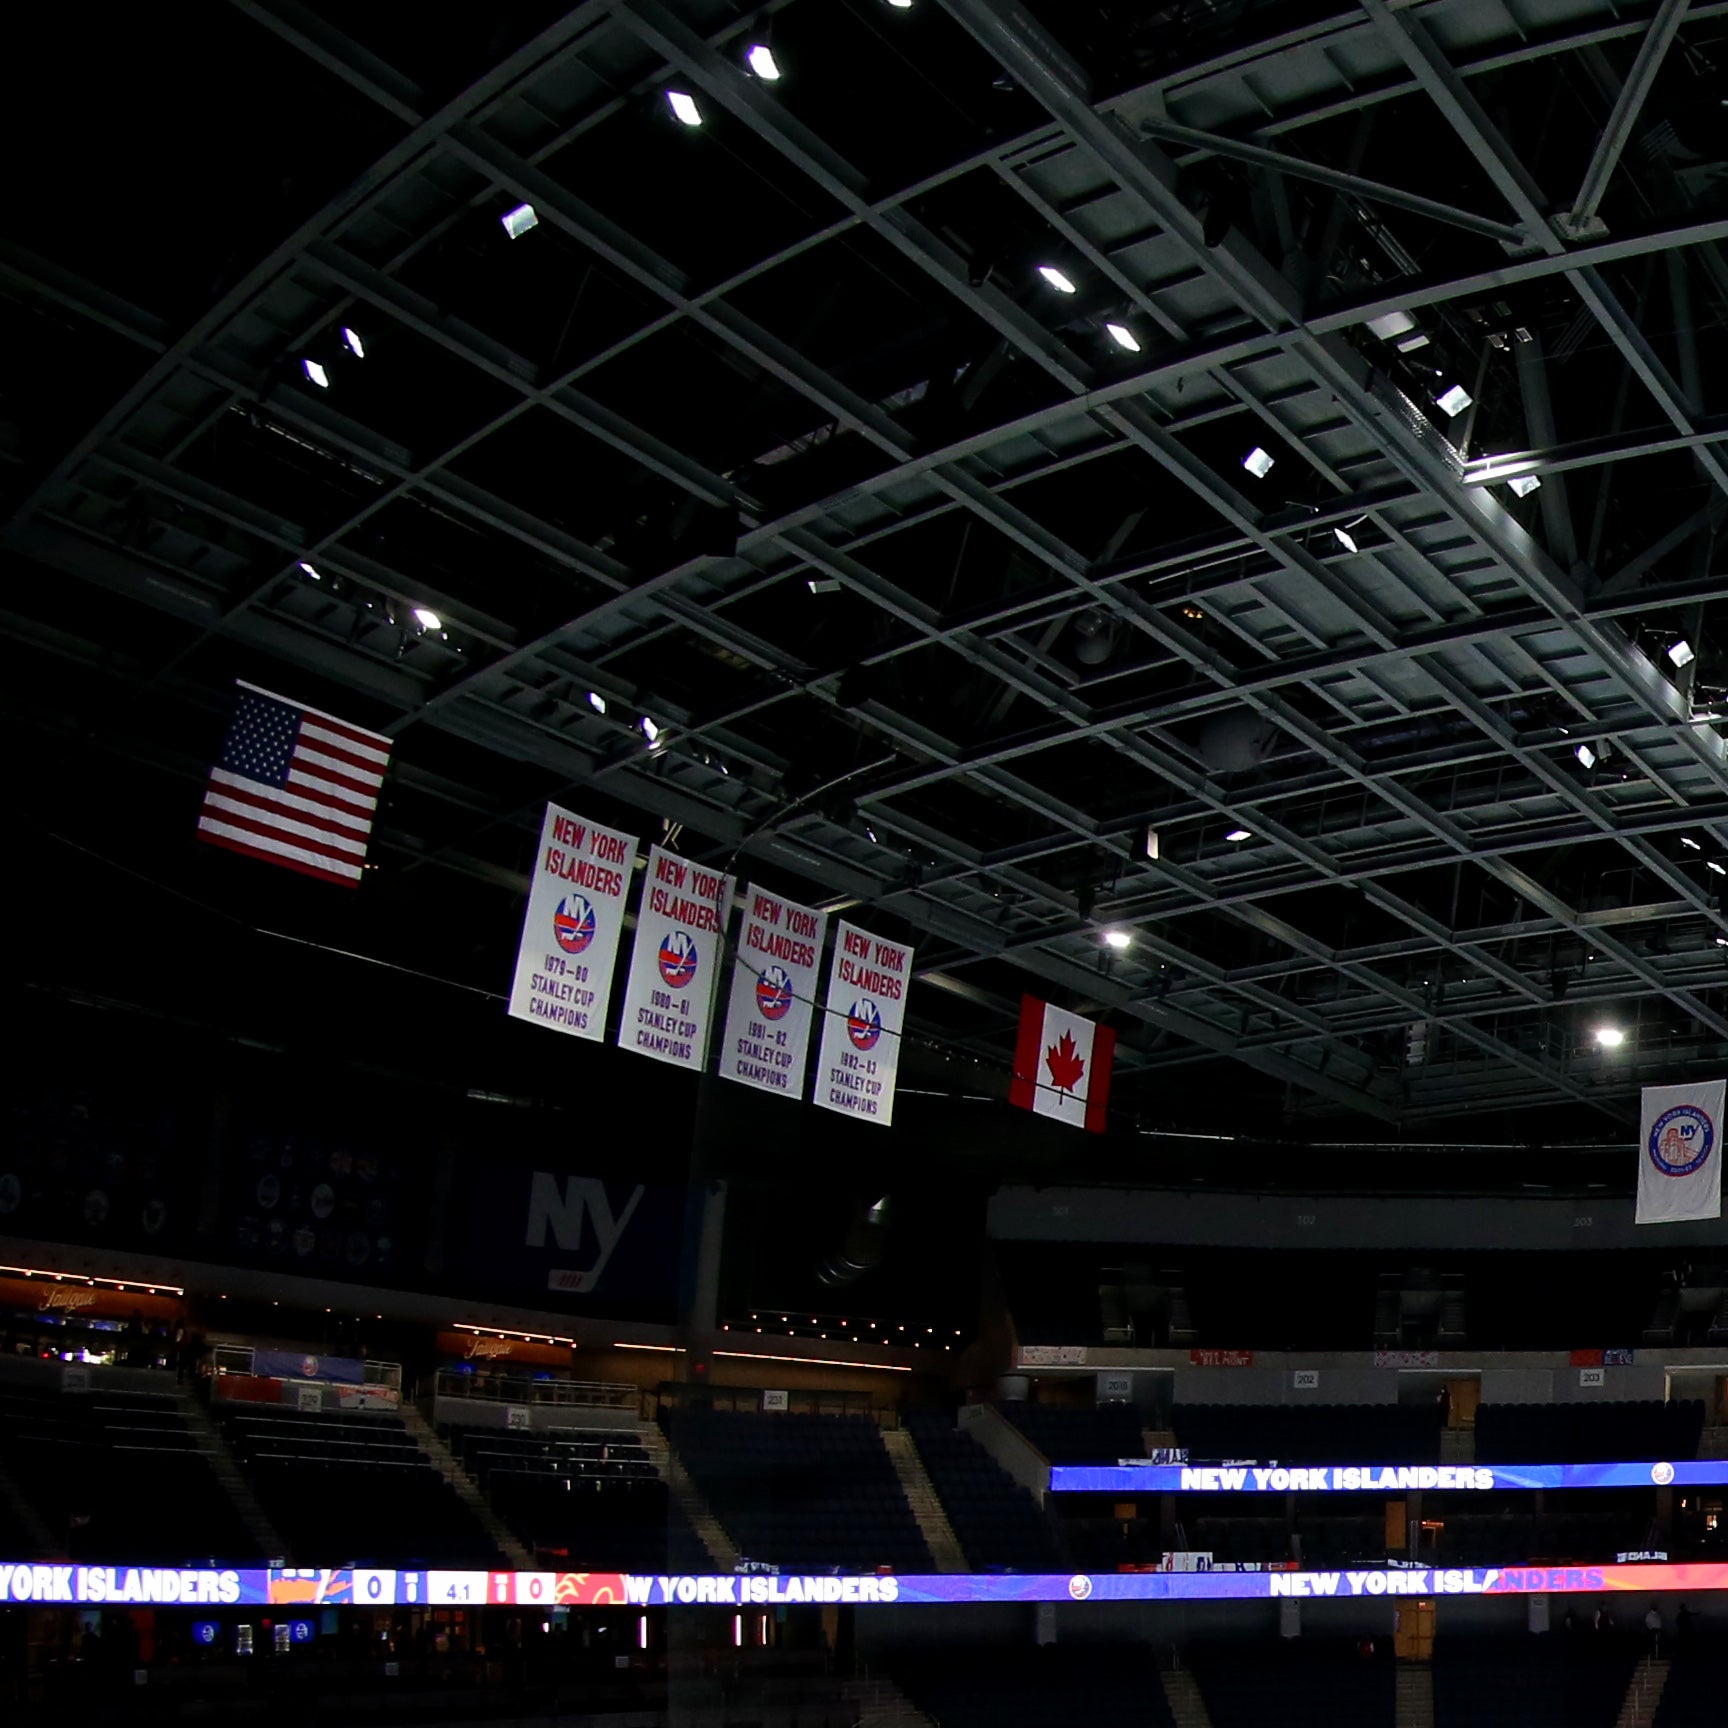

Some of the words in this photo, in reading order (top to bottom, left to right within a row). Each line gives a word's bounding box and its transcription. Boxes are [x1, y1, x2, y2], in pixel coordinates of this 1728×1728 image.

[553, 815, 585, 849] NEW
[590, 830, 627, 866] YORK
[545, 847, 622, 897] ISLANDERS
[655, 856, 687, 890] NEW
[650, 886, 721, 934] ISLANDERS
[753, 894, 780, 925] NEW
[786, 907, 818, 939] YORK
[747, 923, 815, 969] ISLANDERS
[843, 930, 871, 959] NEW
[875, 942, 905, 972] YORK
[531, 973, 573, 1003] STANLEY
[574, 987, 594, 1008] CUP
[838, 958, 902, 1000] ISLANDERS
[529, 997, 588, 1030] CHAMPIONS
[637, 1007, 677, 1034] STANLEY
[678, 1020, 697, 1040] CUP
[637, 1030, 692, 1060] CHAMPIONS
[737, 1038, 774, 1064] STANLEY
[774, 1051, 792, 1069] CUP
[736, 1060, 788, 1088] CHAMPIONS
[830, 1068, 865, 1091] STANLEY
[865, 1079, 882, 1096] CUP
[829, 1088, 878, 1114] CHAMPIONS
[1297, 1374, 1314, 1384] 202
[1583, 1373, 1600, 1382] 203
[766, 1394, 784, 1406] 231
[1181, 1468, 1247, 1491] NEW
[1252, 1468, 1327, 1491] YORK
[1333, 1467, 1494, 1490] ISLANDERS
[77, 1567, 240, 1604] ISLANDERS
[367, 1576, 382, 1596] 0
[446, 1583, 470, 1601] 4.1
[530, 1577, 542, 1599] 0
[658, 1577, 736, 1603] YORK
[741, 1578, 899, 1603] ISLANDERS
[1270, 1572, 1339, 1596] NEW
[1346, 1570, 1427, 1594] YORK
[1432, 1567, 1604, 1593] ISLANDERS
